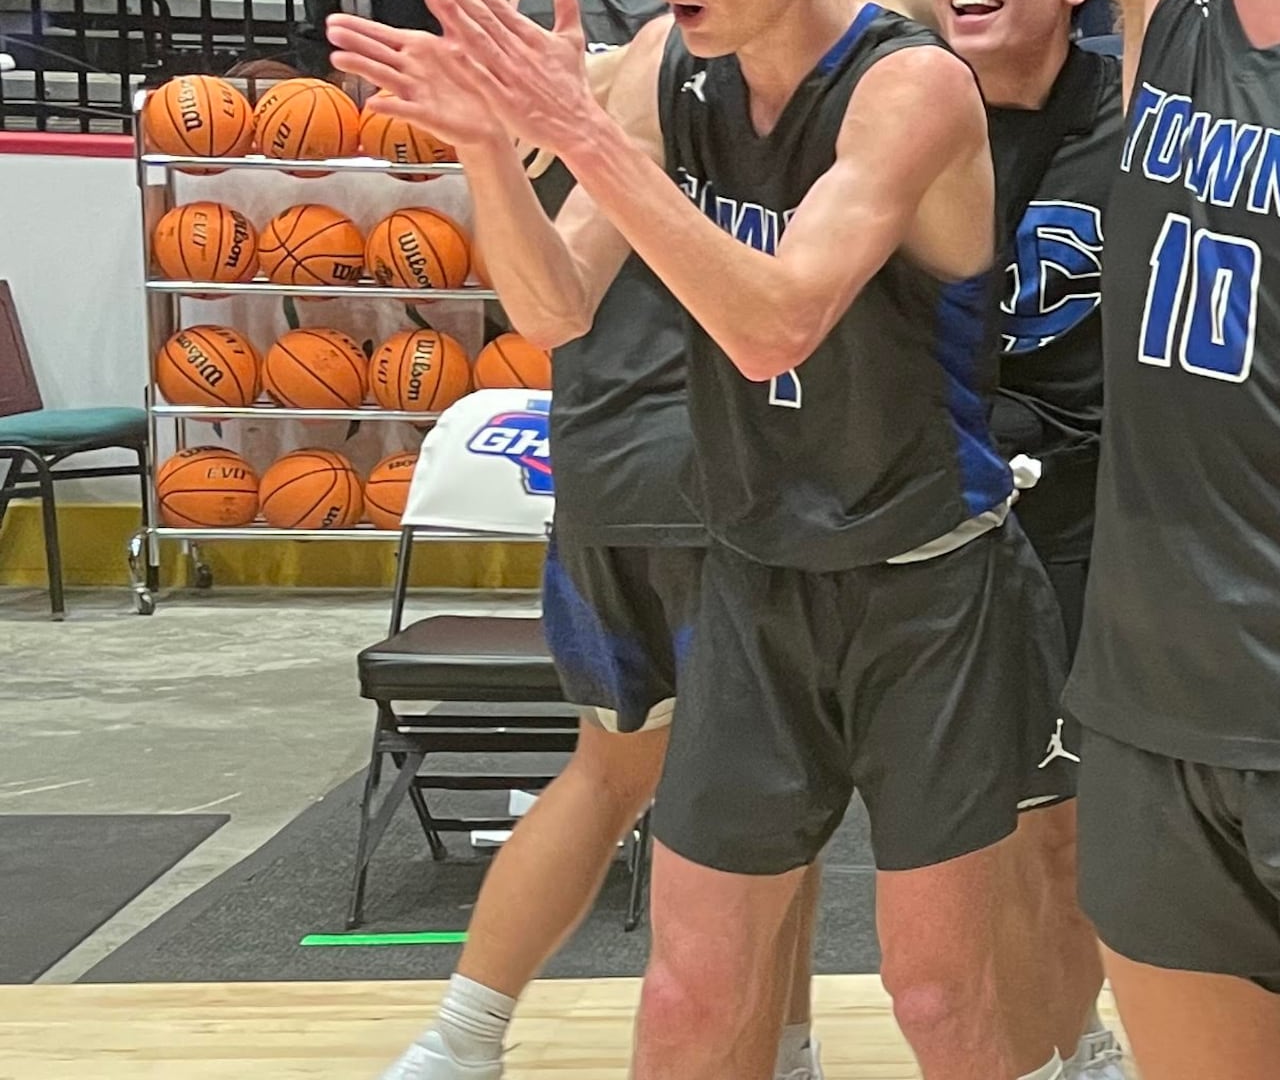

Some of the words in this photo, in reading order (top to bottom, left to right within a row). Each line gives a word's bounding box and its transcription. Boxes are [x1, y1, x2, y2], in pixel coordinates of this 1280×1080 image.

[225, 209, 249, 269] Wilson
[1138, 212, 1262, 383] 10
[175, 334, 224, 388] Wilson
[407, 339, 435, 402] Wilson
[469, 426, 550, 457] GH
